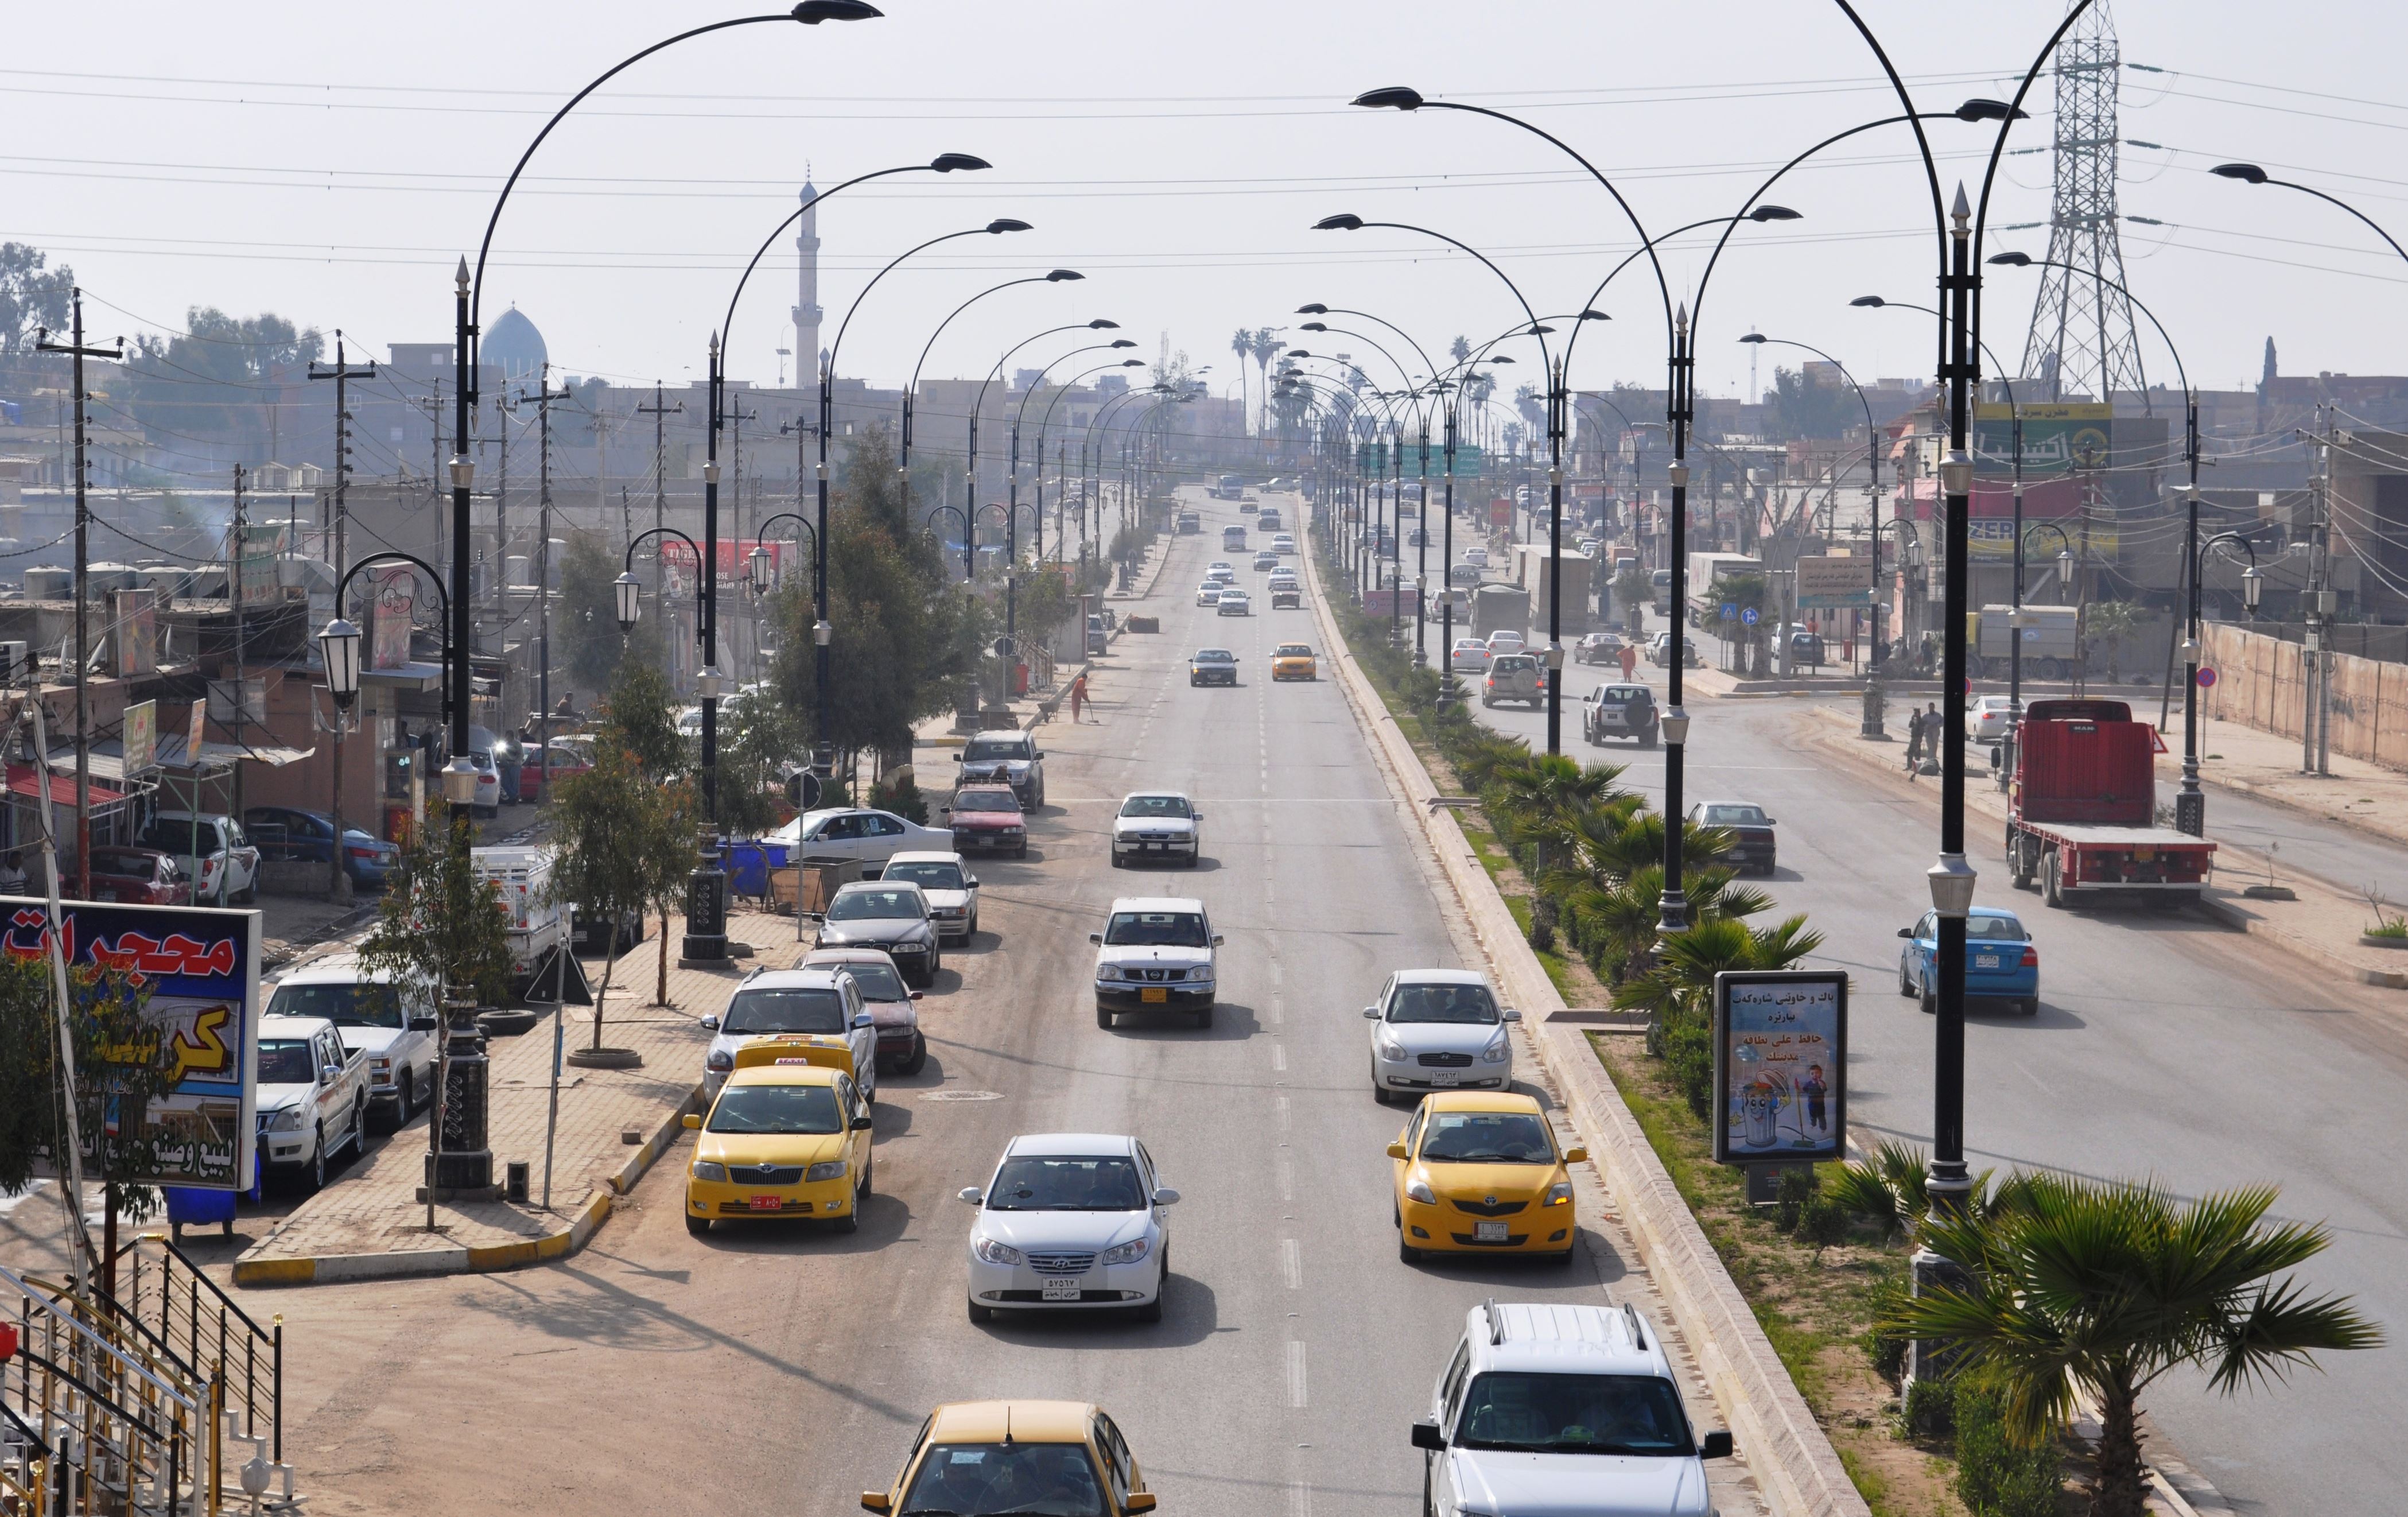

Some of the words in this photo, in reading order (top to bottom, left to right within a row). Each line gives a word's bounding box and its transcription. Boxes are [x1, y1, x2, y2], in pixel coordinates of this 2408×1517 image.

[1799, 1034, 1822, 1044] حافظ
[151, 1133, 195, 1175] وصنع
[197, 1136, 234, 1178] لبيع
[1048, 1279, 1075, 1287] ٥٧٥٦٧
